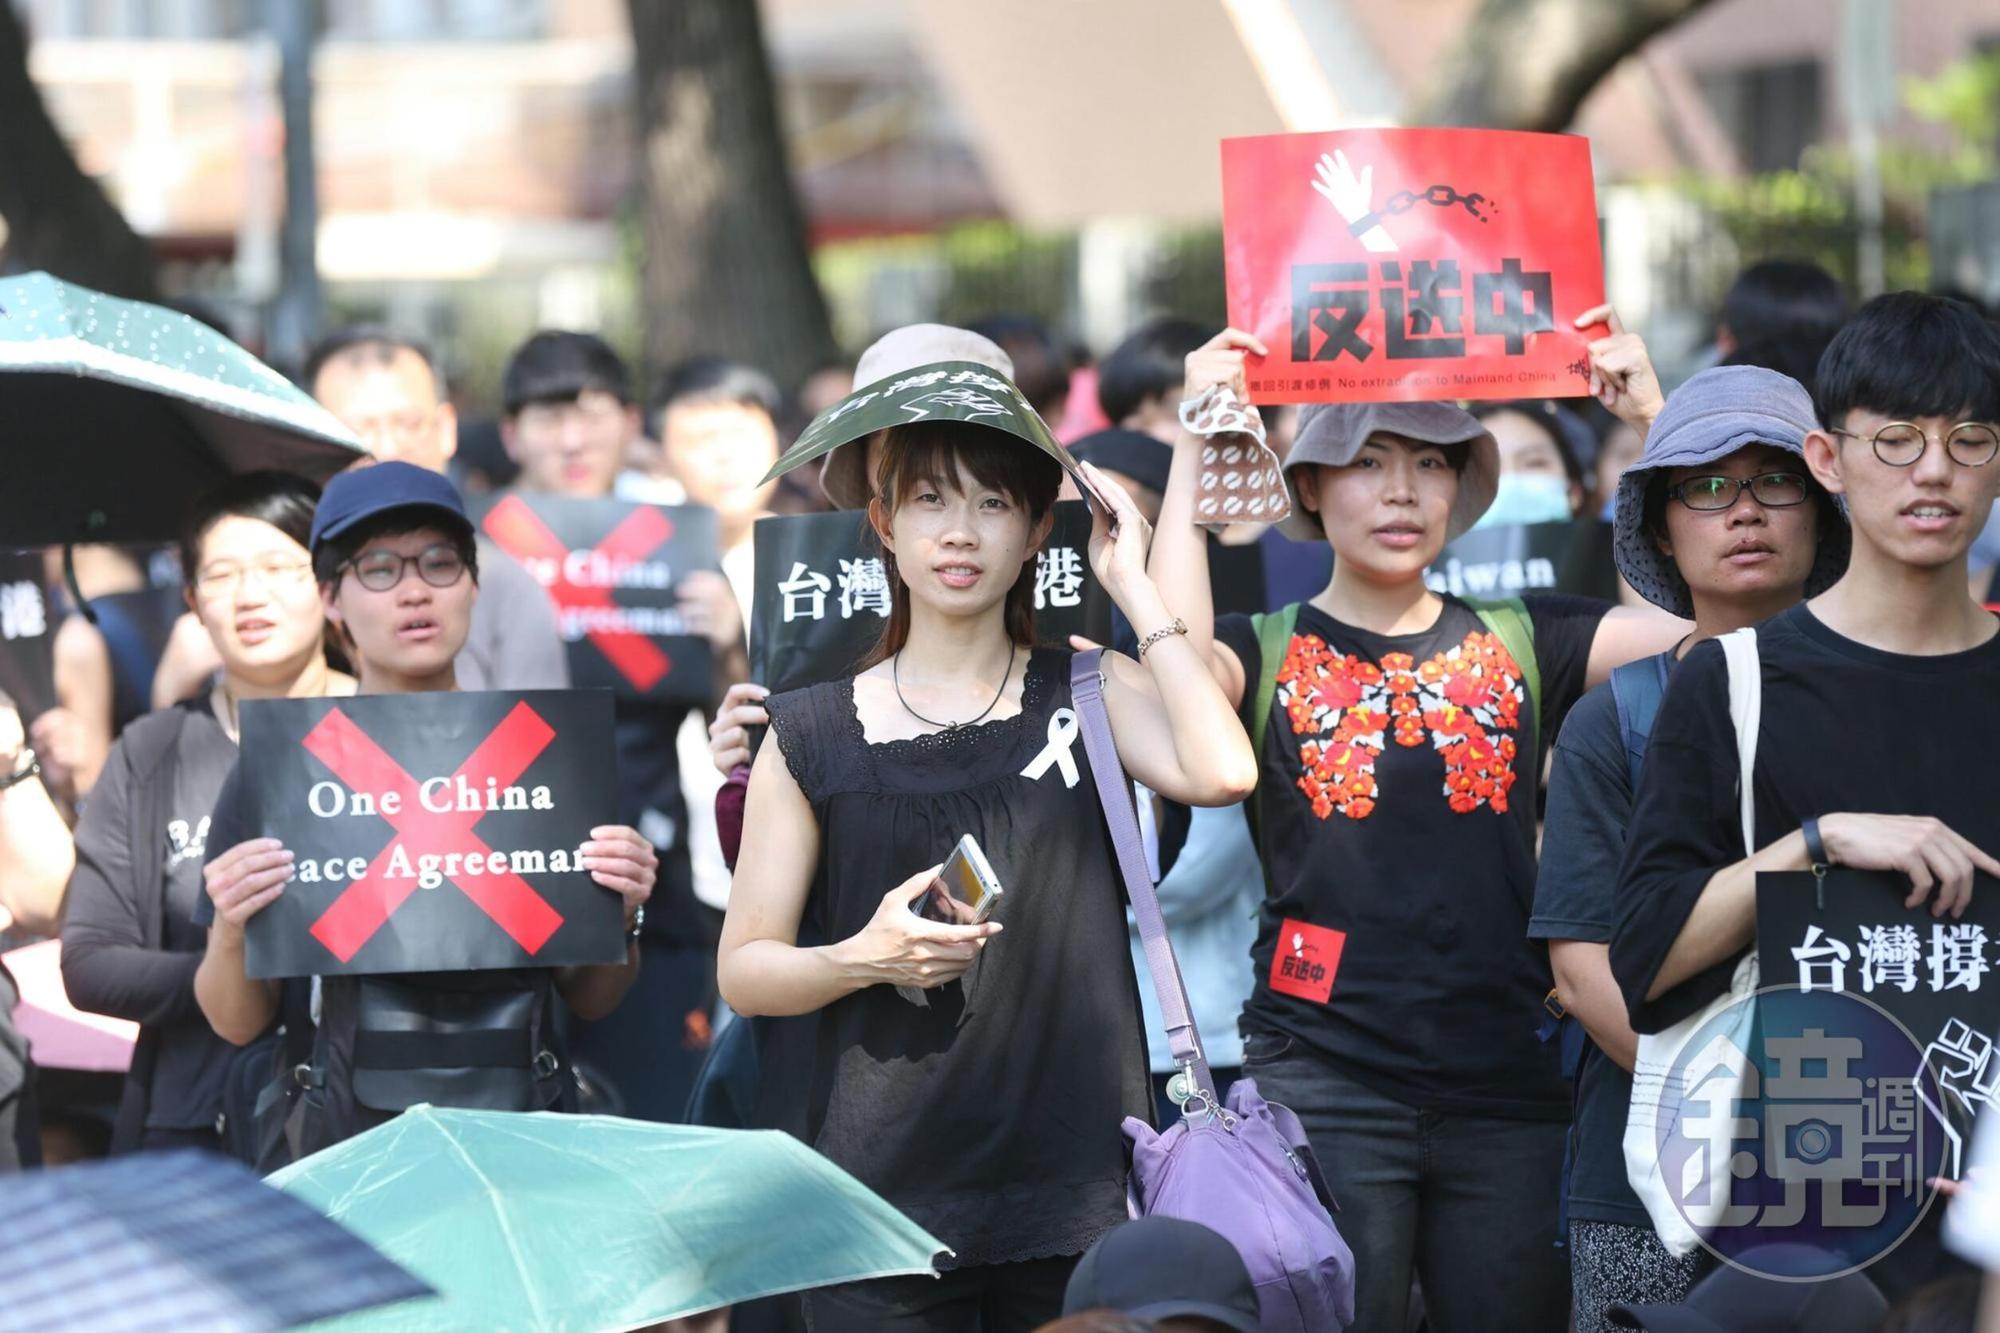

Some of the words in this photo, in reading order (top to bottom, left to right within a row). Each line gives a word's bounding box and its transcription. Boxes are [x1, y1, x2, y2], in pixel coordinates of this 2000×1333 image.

[1291, 258, 1554, 363] 反送中
[1338, 377, 1356, 389] No
[1436, 374, 1448, 385] to
[1454, 371, 1513, 385] Mainland
[1518, 370, 1556, 384] China
[563, 548, 671, 588] China
[1423, 558, 1556, 597] aiwan
[308, 781, 401, 818] One
[419, 774, 555, 813] China
[1281, 955, 1326, 984] 反送中
[1791, 924, 2000, 993] 台灣撐
